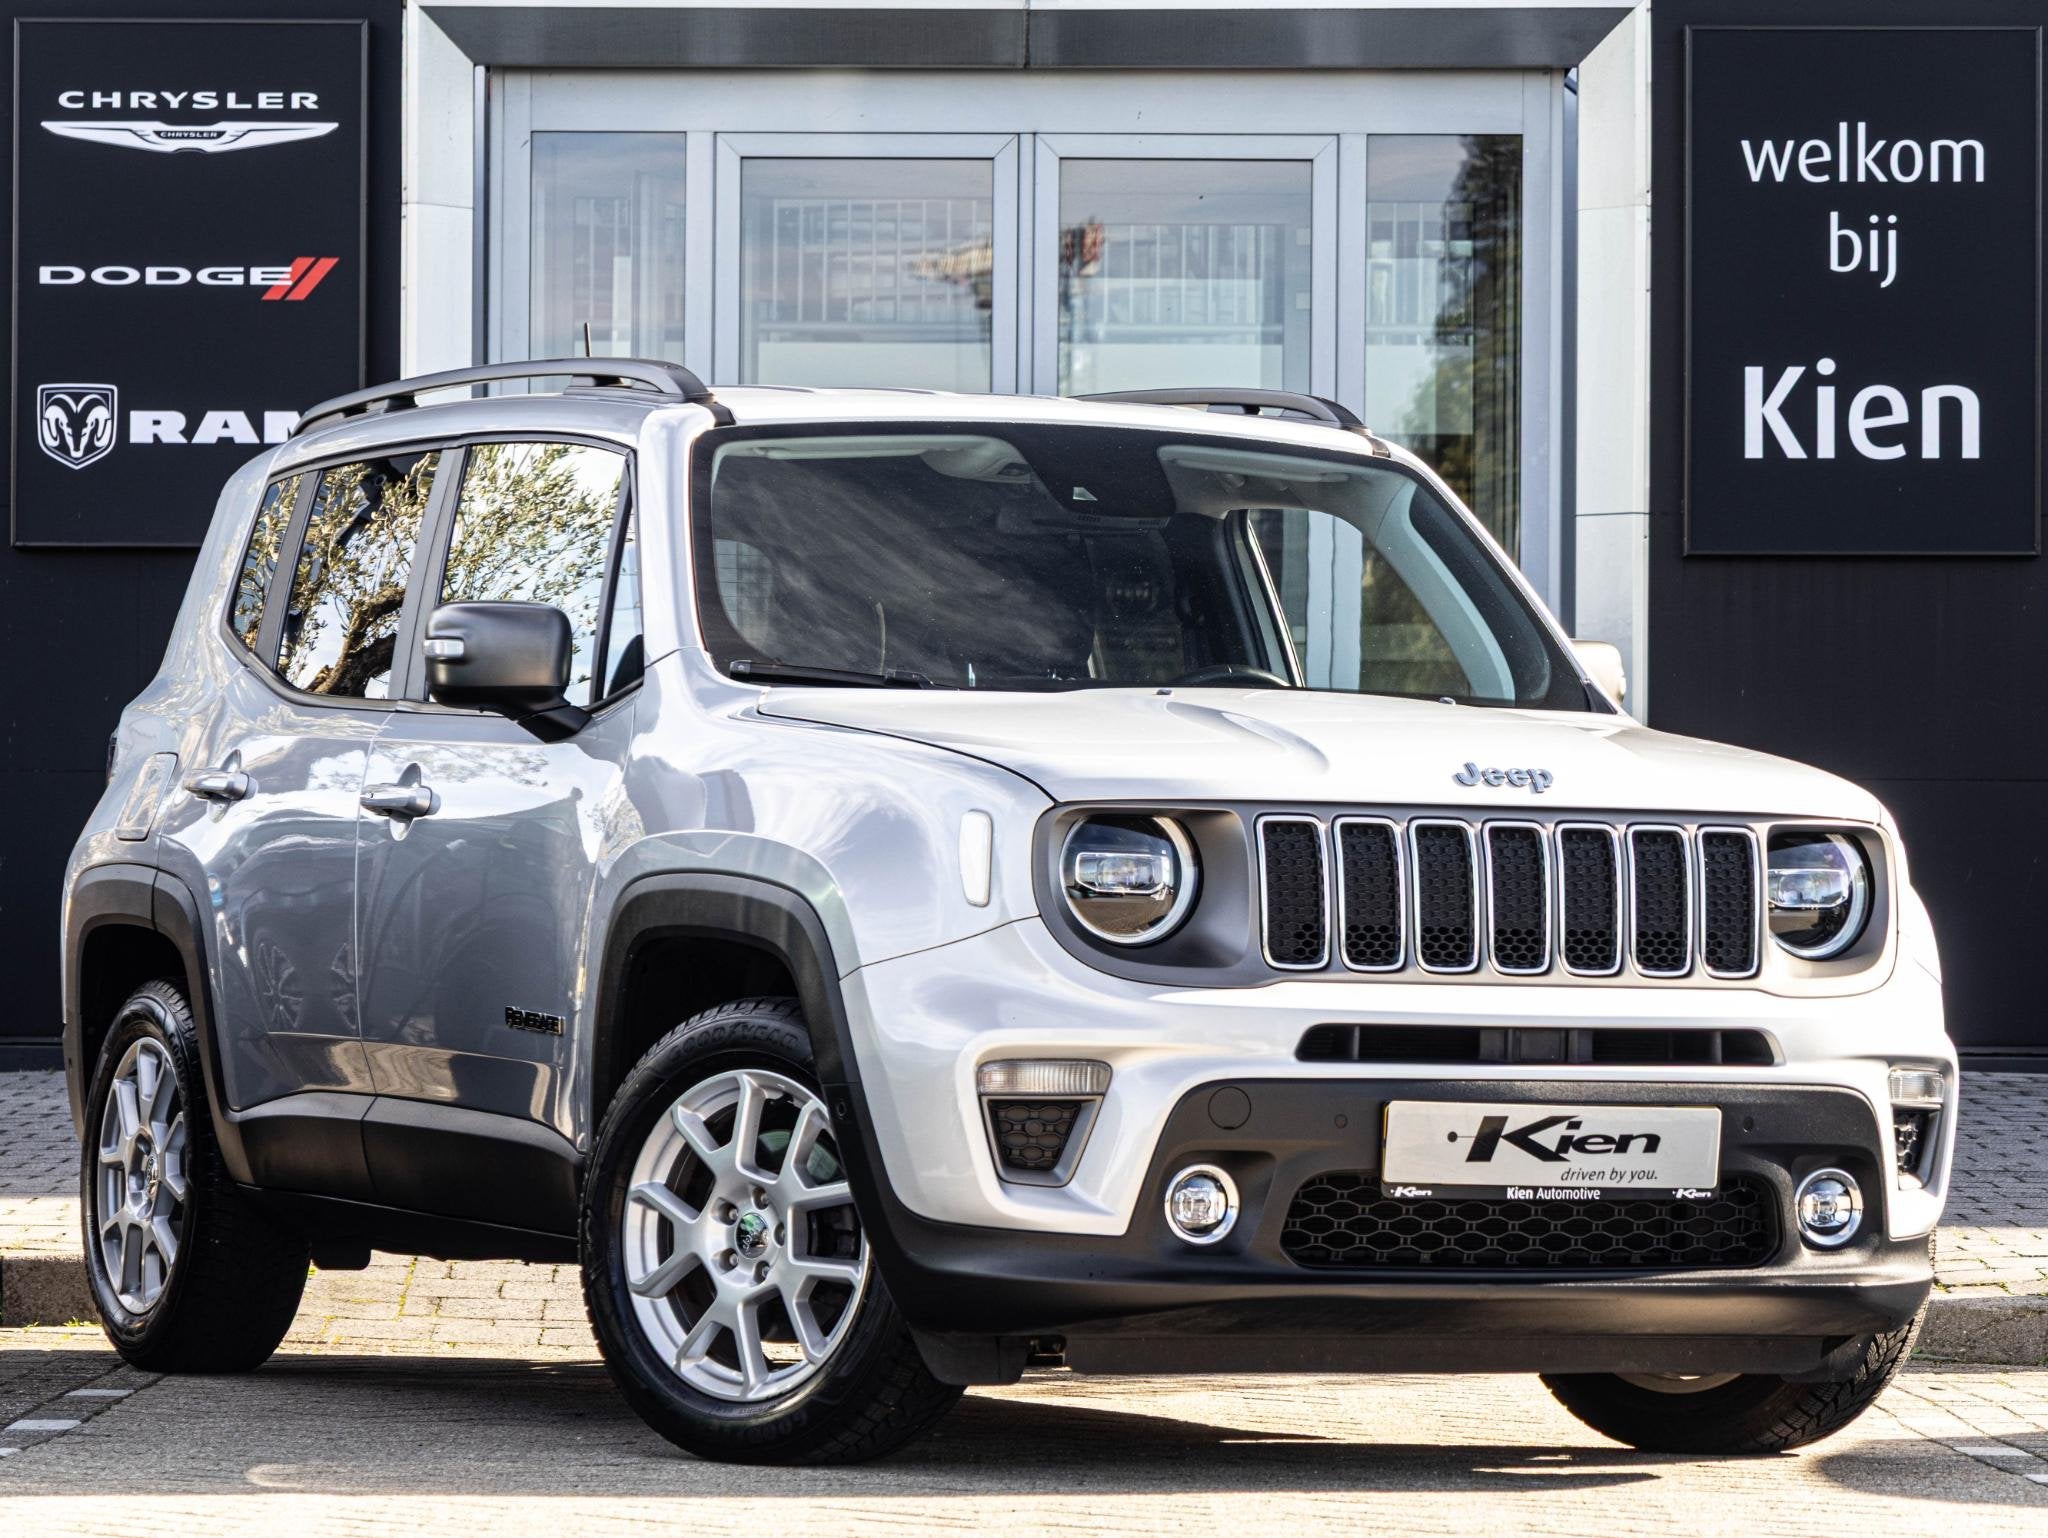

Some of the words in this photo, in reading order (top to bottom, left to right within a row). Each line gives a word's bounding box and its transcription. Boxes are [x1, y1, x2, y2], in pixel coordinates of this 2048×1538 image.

[57, 90, 319, 110] CHRYSLER
[1741, 121, 1985, 183] welkom
[1829, 211, 1898, 288] bij
[39, 265, 293, 285] DODGE
[1744, 357, 1981, 461] Kien
[1453, 762, 1553, 793] Jeep
[1466, 1115, 1661, 1162] Kien
[1561, 1168, 1605, 1181] driven
[1609, 1167, 1627, 1183] by
[1629, 1170, 1658, 1183] you.
[1394, 1186, 1432, 1197] Kien
[1507, 1187, 1533, 1199] Kien
[1536, 1187, 1601, 1199] Automotive
[1676, 1189, 1712, 1199] Kien
